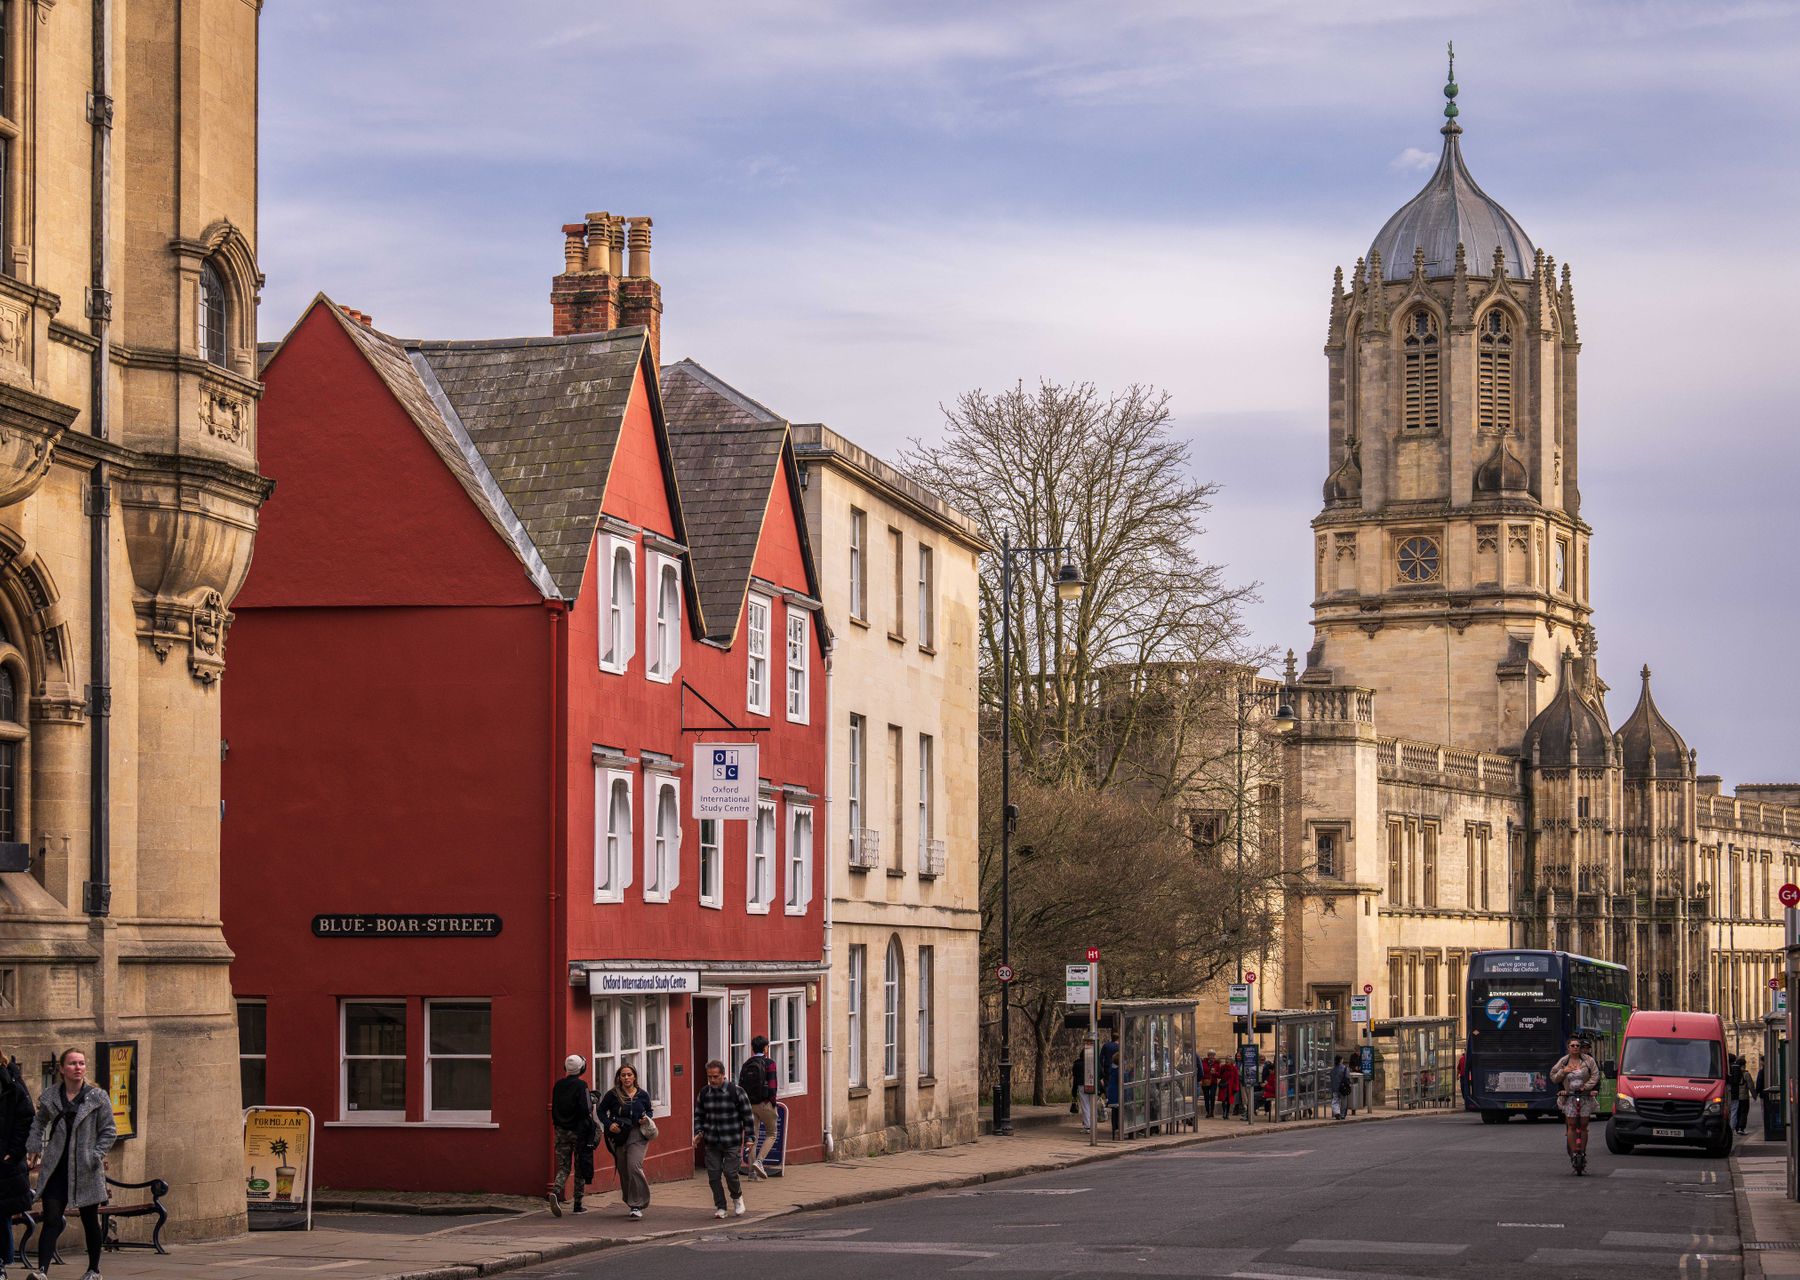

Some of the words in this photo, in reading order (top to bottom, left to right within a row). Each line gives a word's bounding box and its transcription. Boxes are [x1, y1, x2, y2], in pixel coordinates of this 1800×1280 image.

[1781, 890, 1797, 900] G4
[1088, 950, 1098, 959] H1
[603, 975, 620, 990] Oxford
[621, 975, 655, 990] International
[655, 975, 670, 992] Study
[670, 974, 687, 989] Centre
[1521, 1016, 1547, 1024] amping
